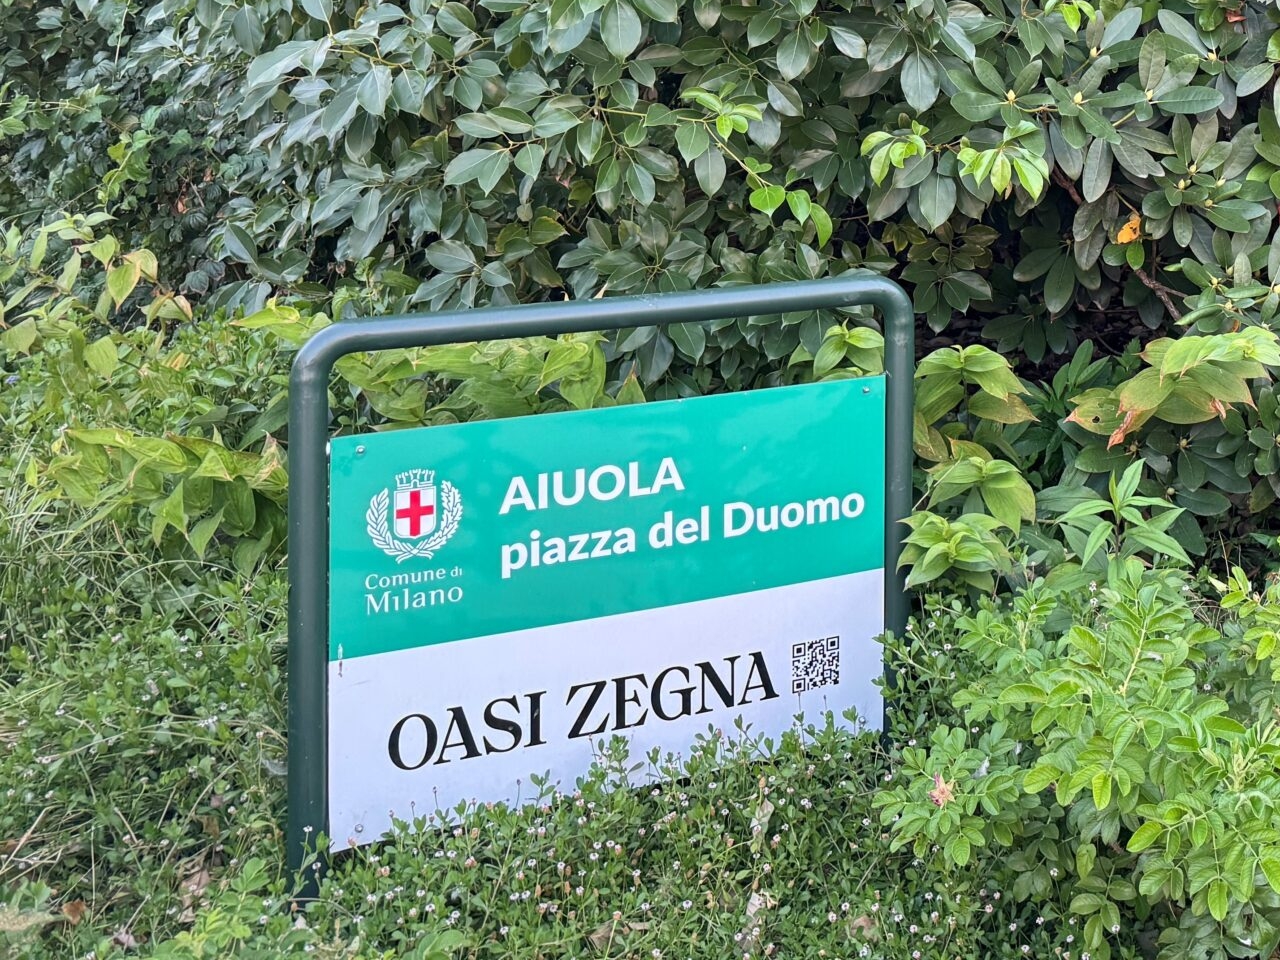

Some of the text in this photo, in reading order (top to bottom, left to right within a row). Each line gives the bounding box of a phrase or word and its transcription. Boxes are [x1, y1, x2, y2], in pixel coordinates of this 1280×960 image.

[499, 457, 684, 515] AIUOLA
[500, 492, 865, 579] piazza del Duomo
[365, 566, 463, 590] Comune di
[366, 586, 463, 615] Milano
[387, 650, 780, 771] OASI ZEGNA
